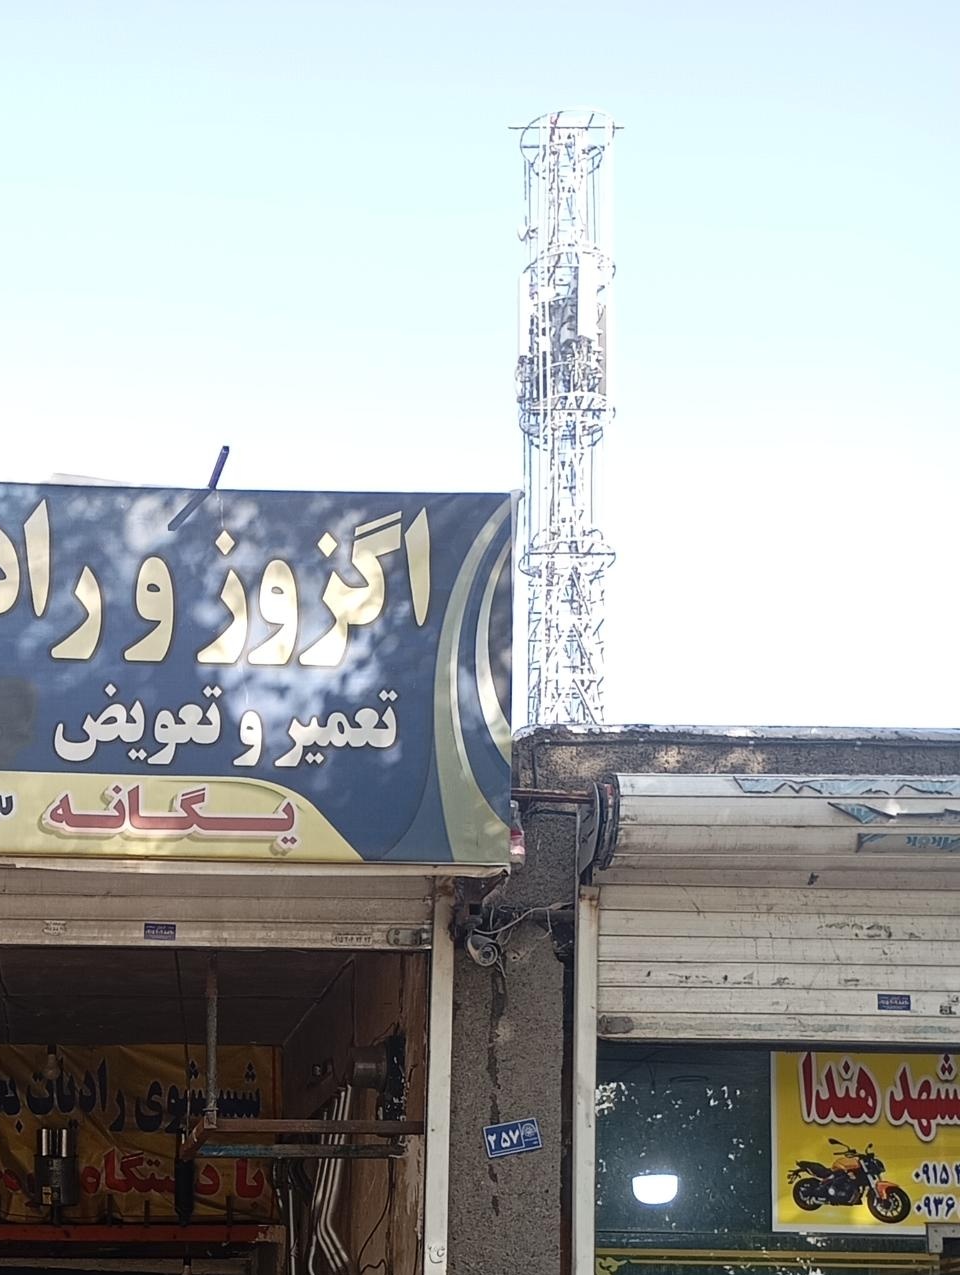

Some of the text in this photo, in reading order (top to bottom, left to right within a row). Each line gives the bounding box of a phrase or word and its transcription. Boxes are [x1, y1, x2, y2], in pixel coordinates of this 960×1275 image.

[123, 555, 176, 663] و
[195, 506, 432, 667] اگزوز
[53, 683, 398, 769] تعمیر و تعویض
[801, 1052, 960, 1137] هندا شهد
[487, 1128, 520, 1150] ۲۵۷
